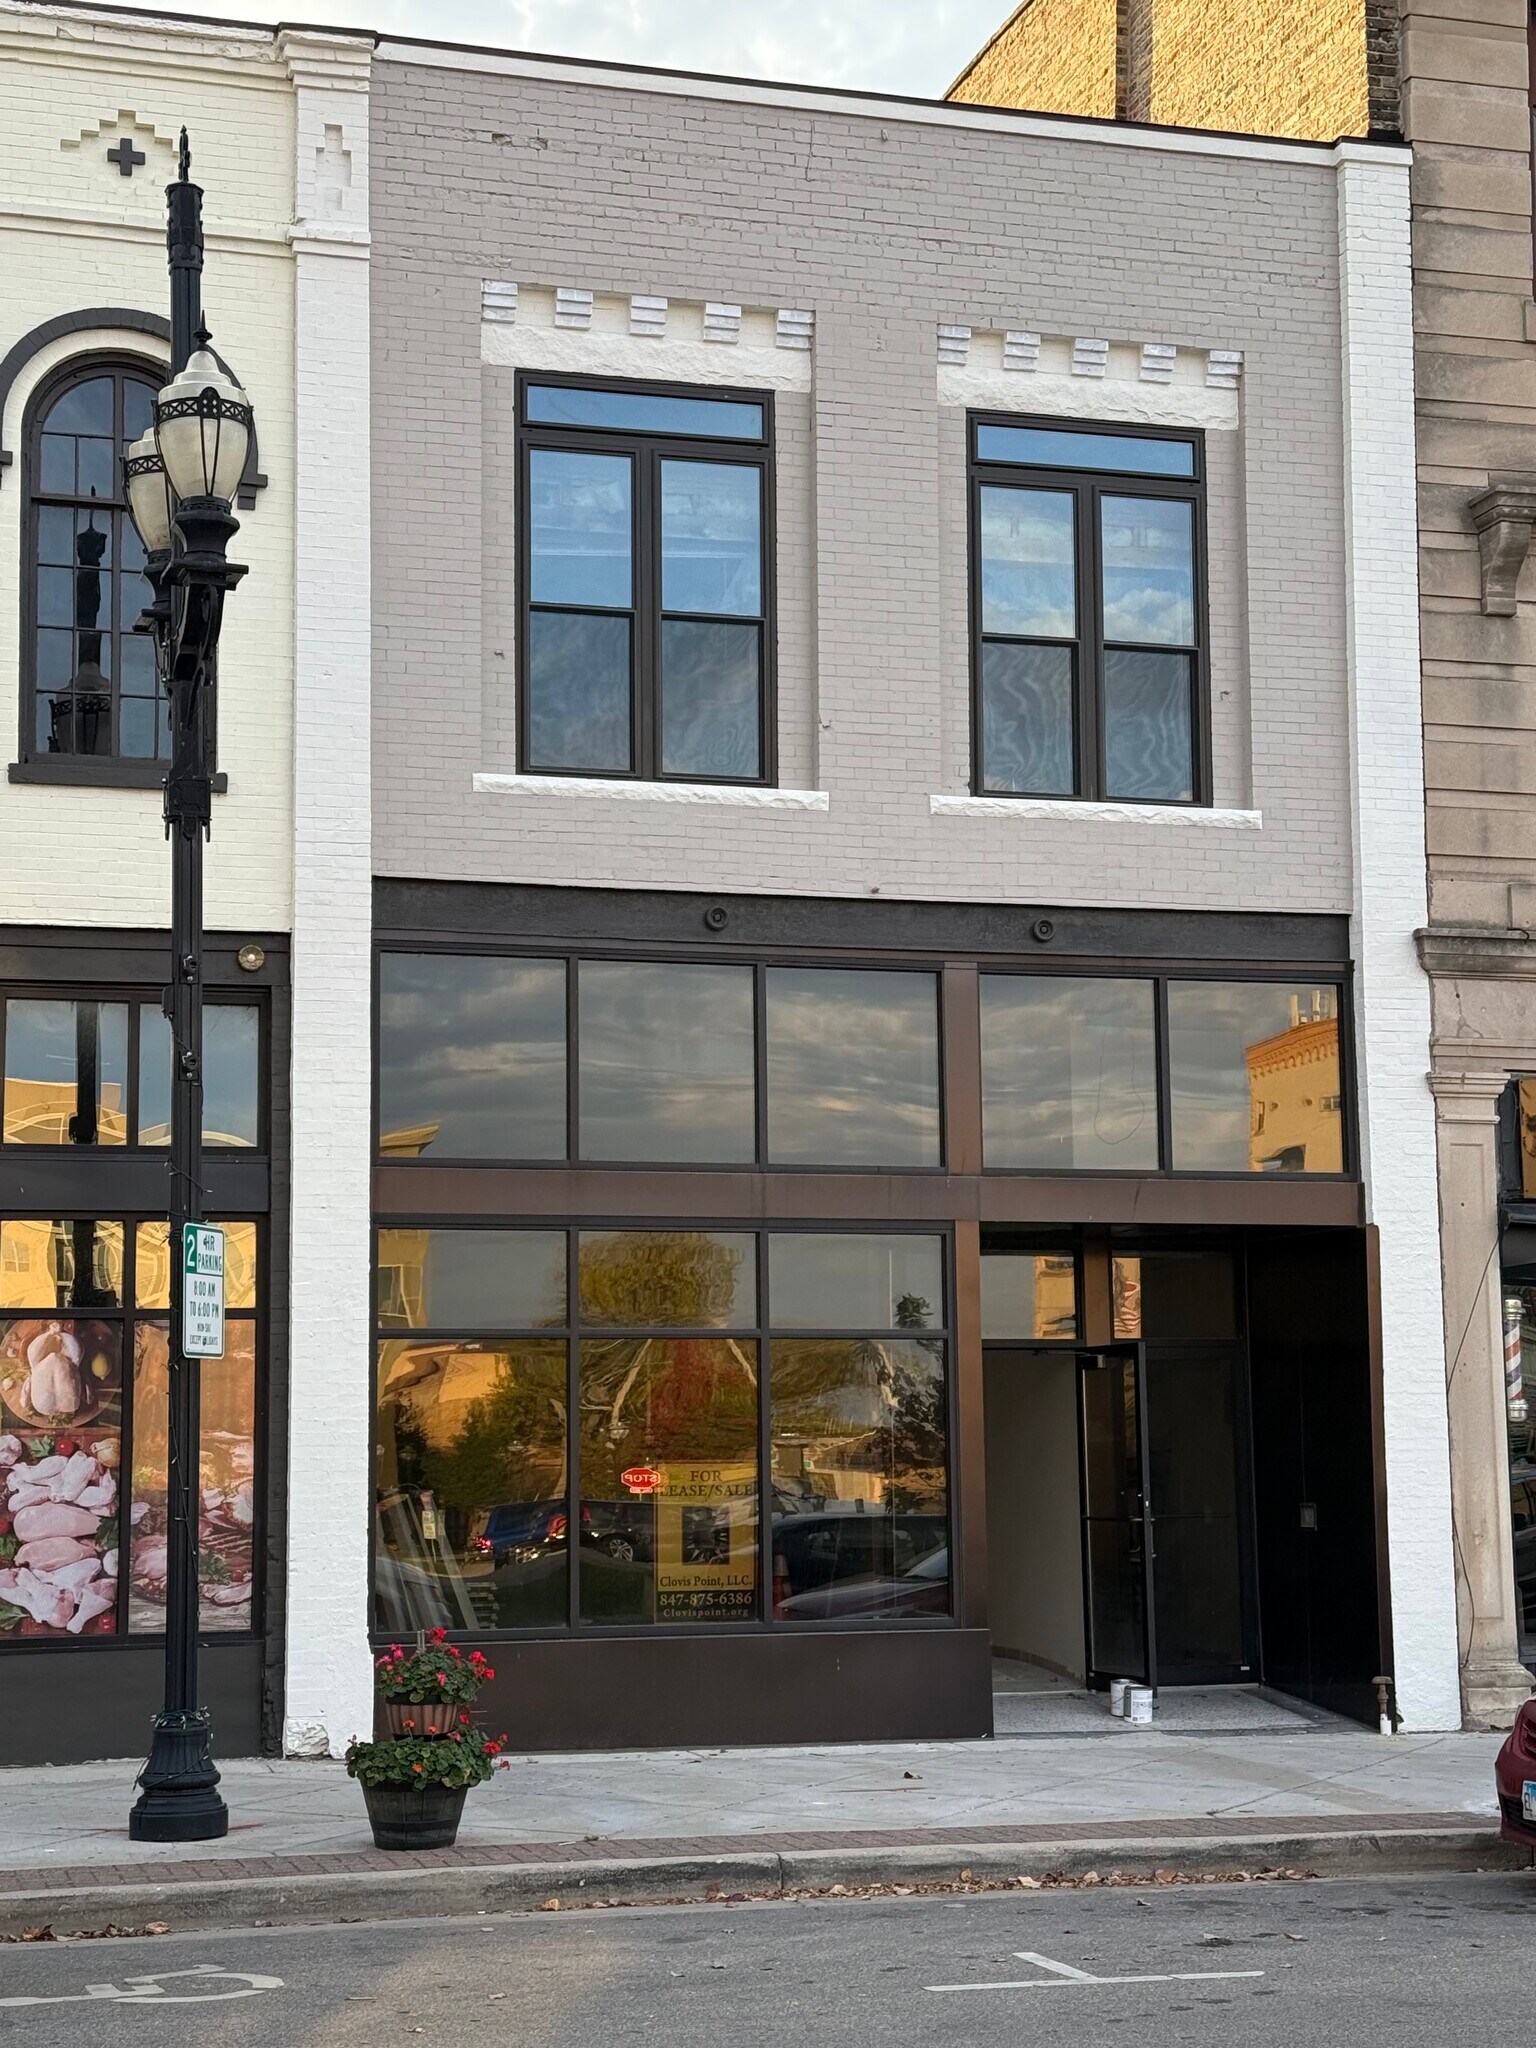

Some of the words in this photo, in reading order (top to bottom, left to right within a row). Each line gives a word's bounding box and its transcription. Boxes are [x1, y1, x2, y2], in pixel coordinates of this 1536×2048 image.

[187, 1234, 195, 1267] 2
[204, 1235, 215, 1251] HR
[198, 1253, 222, 1272] PARKING
[194, 1280, 206, 1296] 8:00
[208, 1282, 216, 1297] AM
[190, 1301, 196, 1316] TO
[198, 1302, 210, 1317] 6:00
[212, 1303, 219, 1318] PM
[690, 1470, 722, 1482] FOR
[660, 1576, 691, 1587] Clovis
[693, 1576, 724, 1588] Point,
[727, 1575, 753, 1586] LLC.
[660, 1592, 752, 1607] 847-875-6386
[663, 1608, 749, 1618] Clovispoint.org
